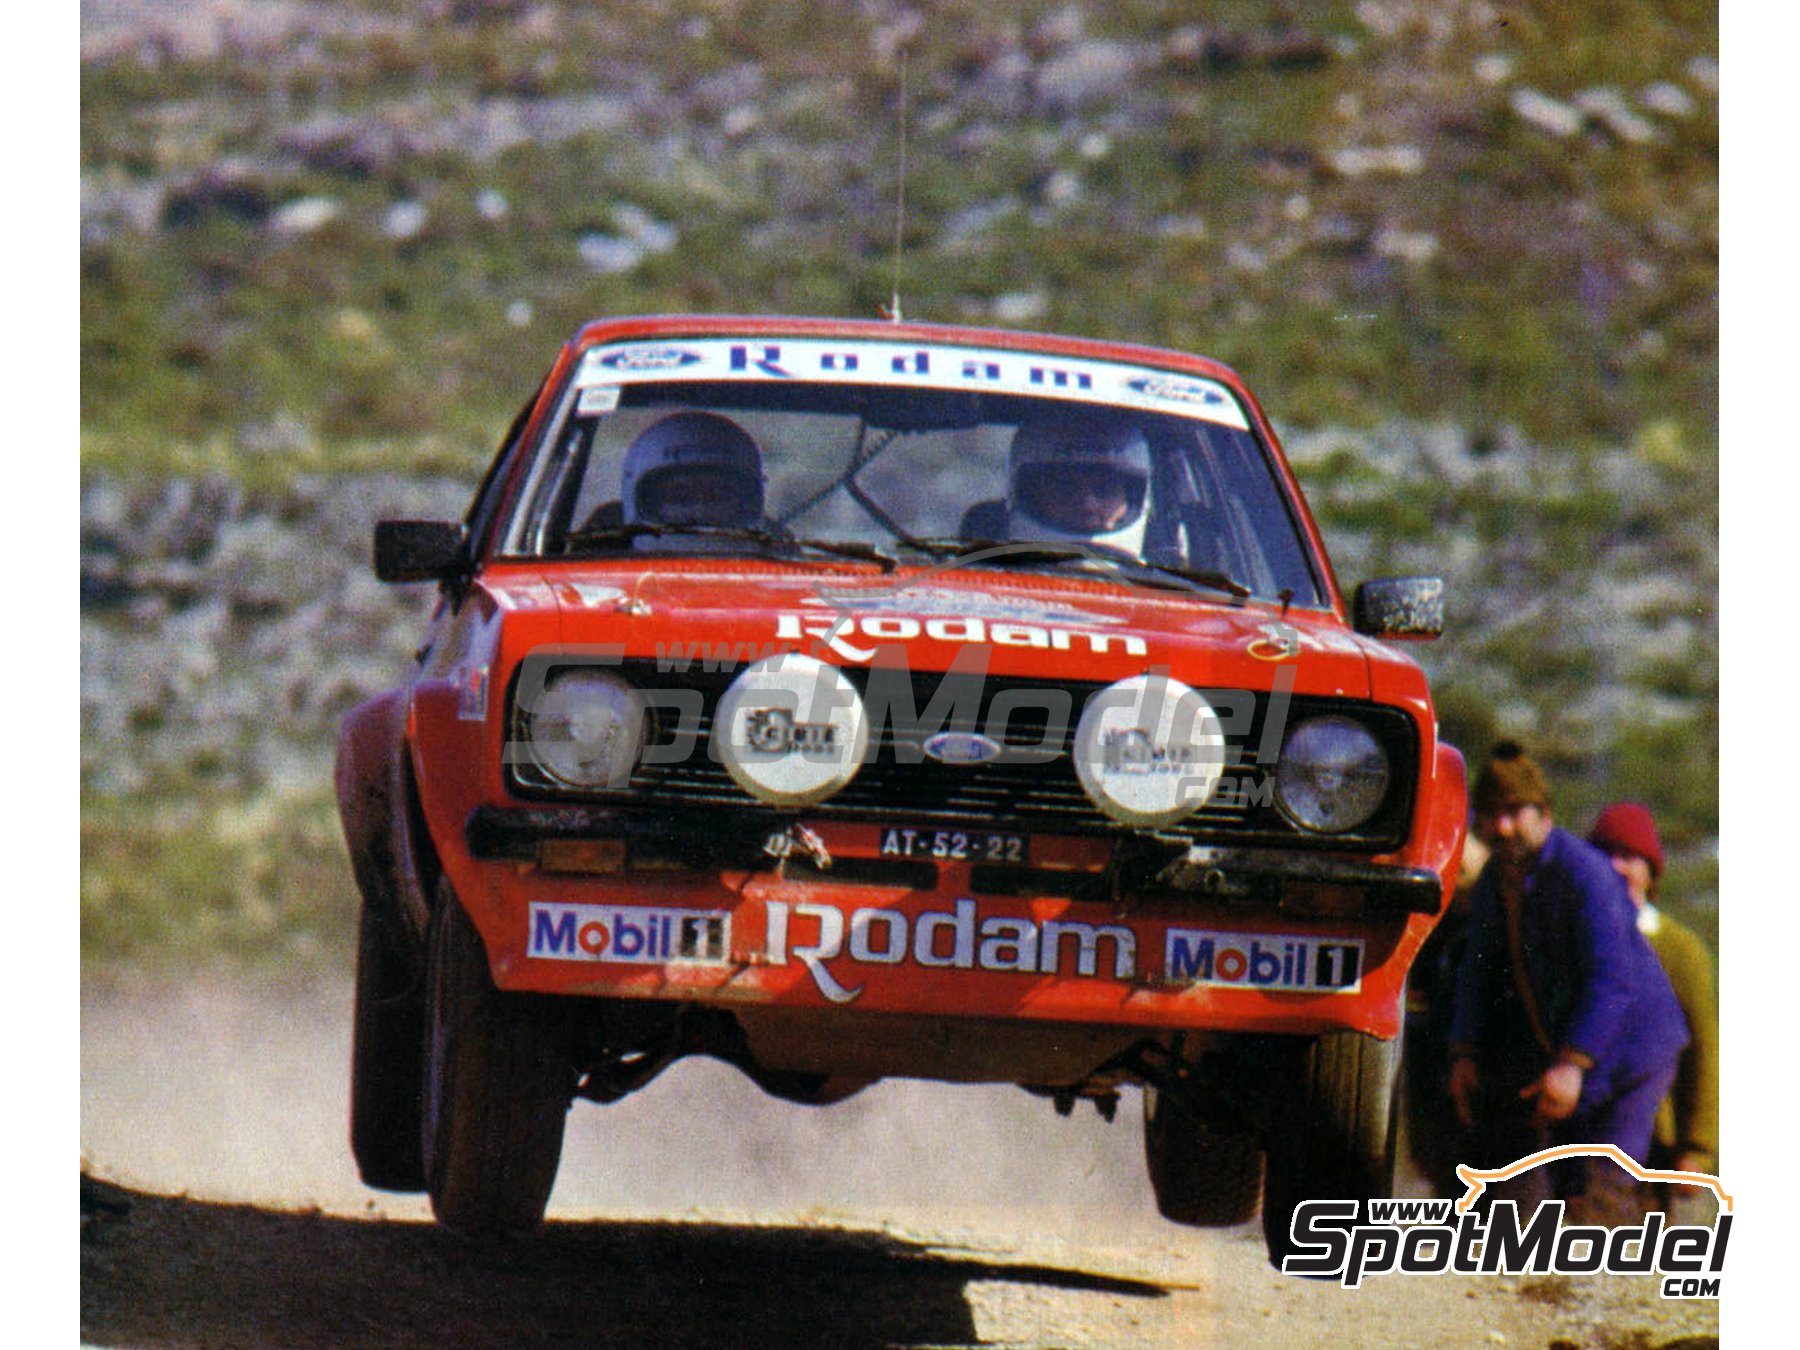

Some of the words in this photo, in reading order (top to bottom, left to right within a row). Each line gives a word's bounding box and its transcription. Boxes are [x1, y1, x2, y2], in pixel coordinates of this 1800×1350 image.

[731, 345, 1092, 389] Rodam
[776, 614, 1147, 662] Rodam
[882, 828, 1023, 862] AT-52-22
[534, 908, 672, 959] Mobil
[765, 898, 1136, 1003] Rodam
[1171, 936, 1307, 986] Mobil
